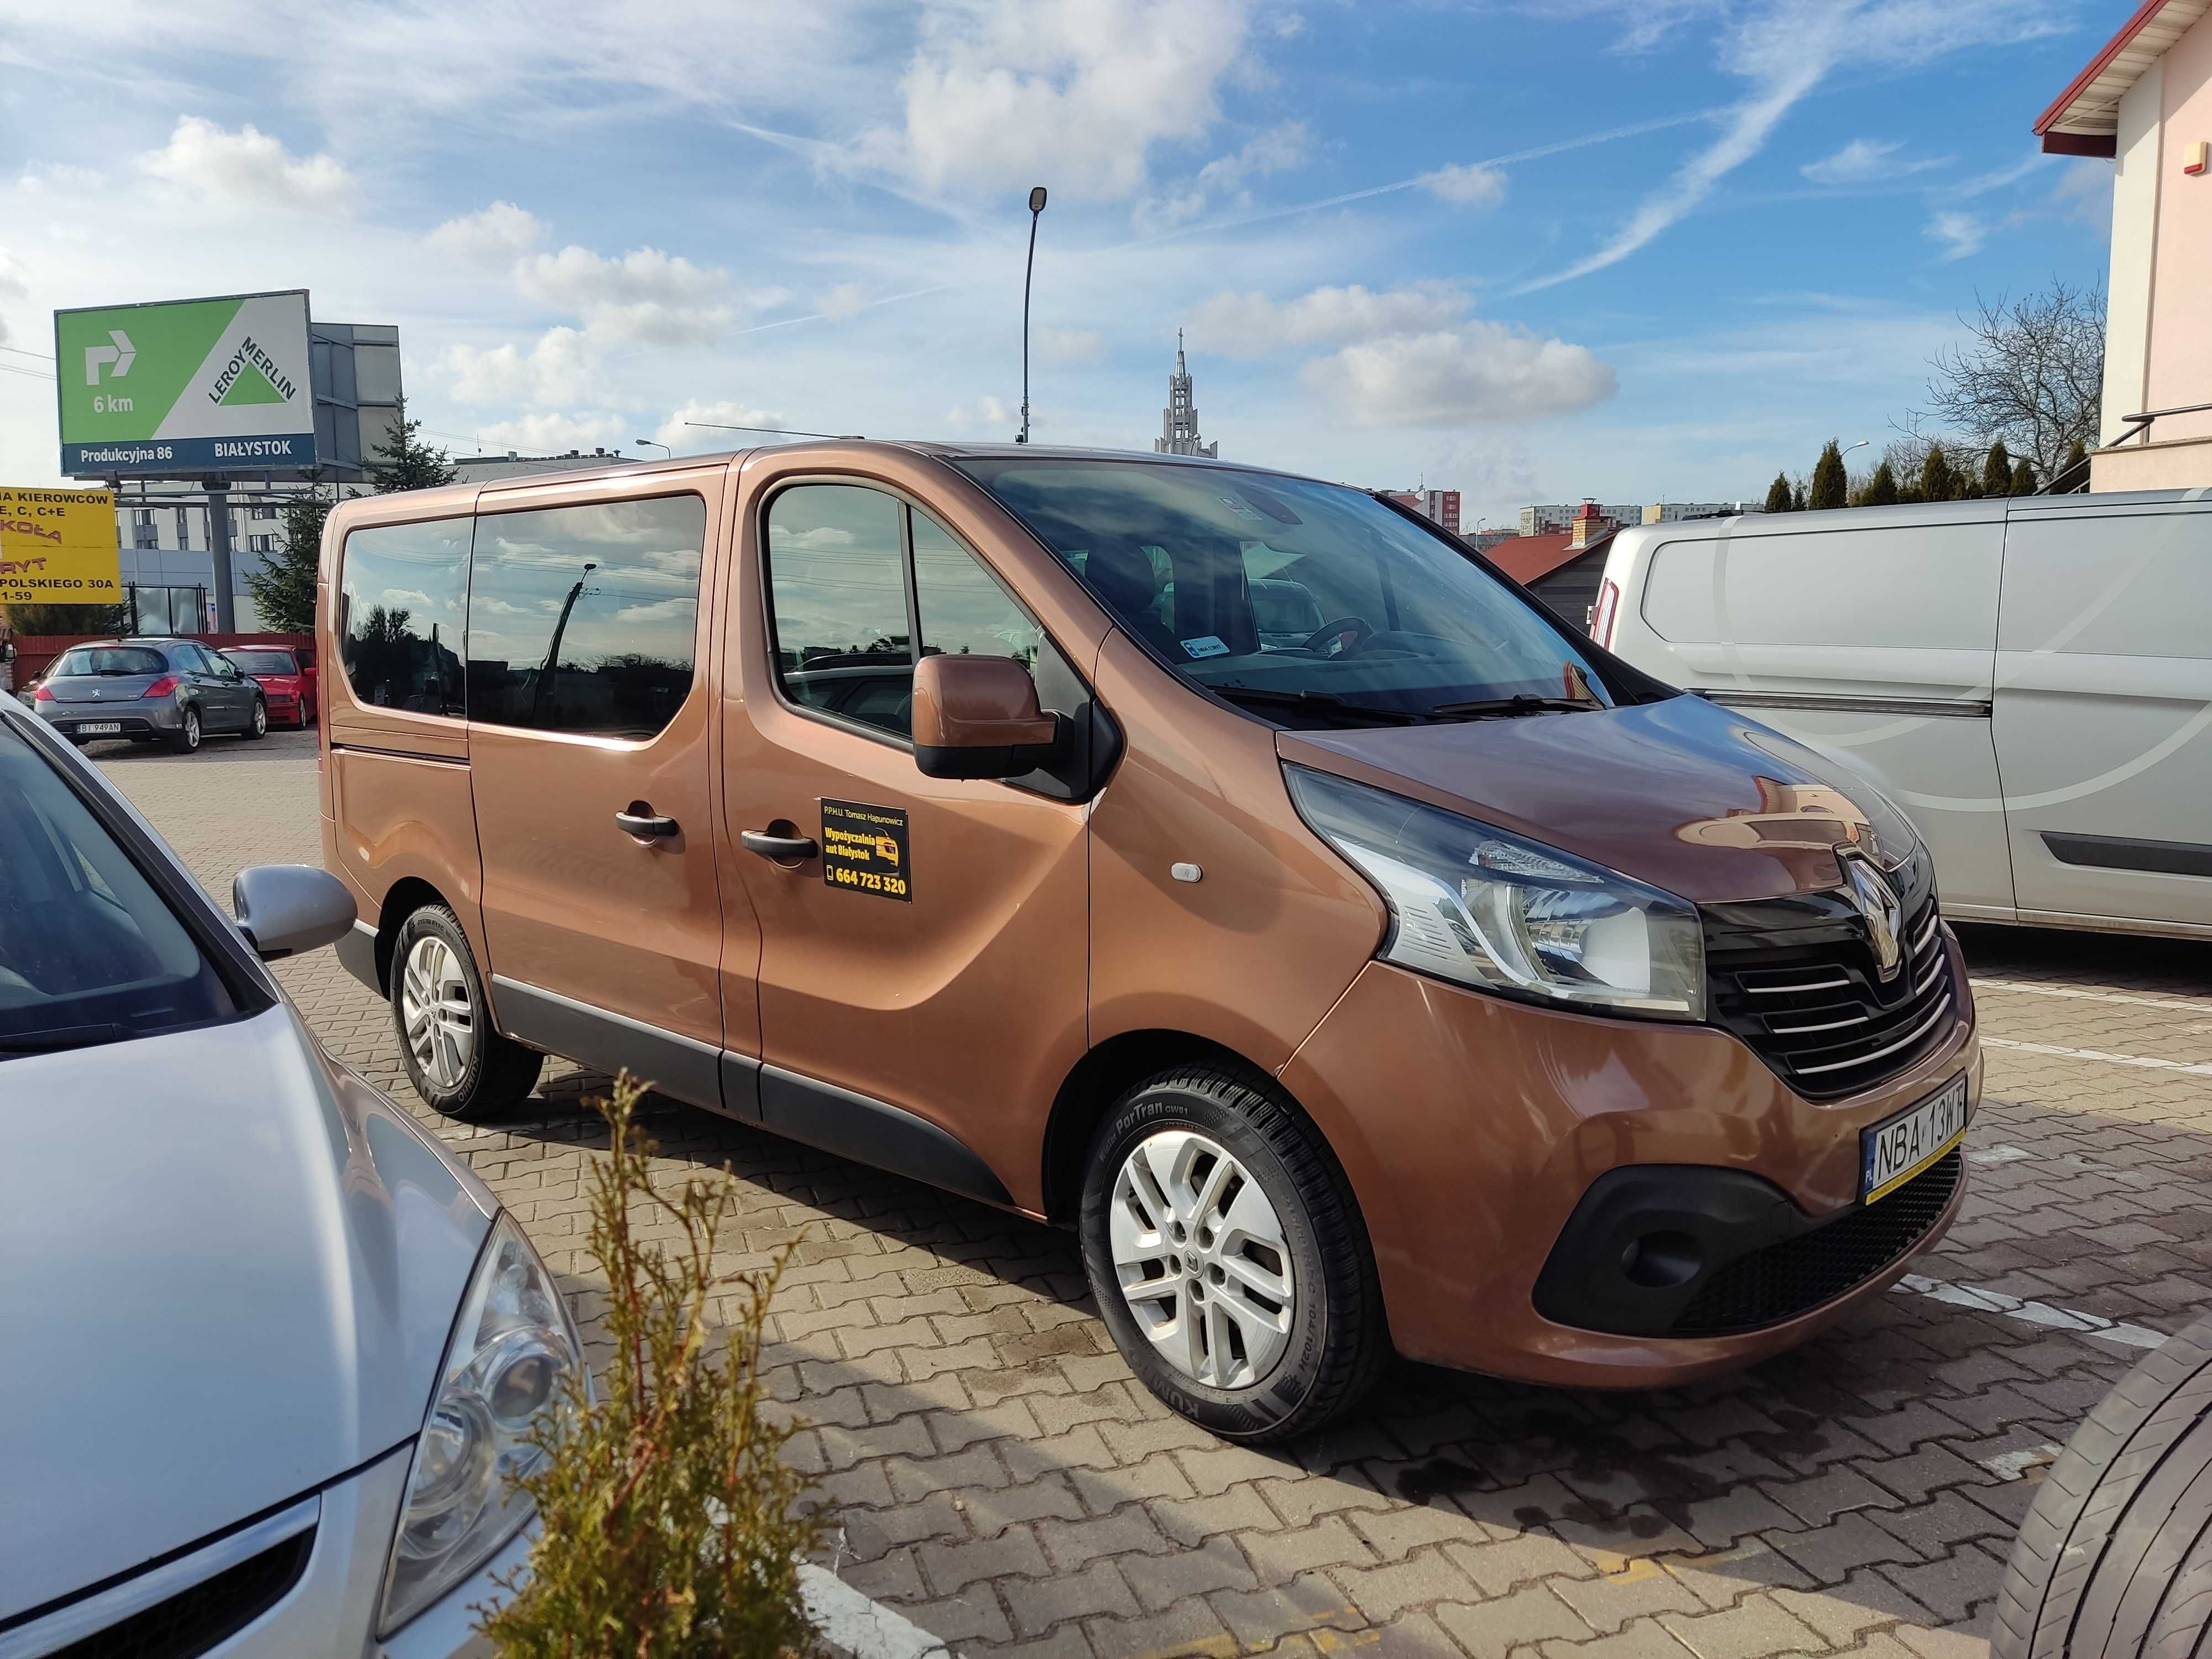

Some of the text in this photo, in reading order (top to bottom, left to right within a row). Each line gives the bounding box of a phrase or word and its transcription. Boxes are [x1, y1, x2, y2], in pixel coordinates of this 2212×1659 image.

[208, 336, 296, 404] LEROY MERLIN
[93, 395, 133, 413] 6 km
[81, 446, 173, 463] Produkcyjna 86
[215, 440, 292, 457] BIAŁYSTOK
[18, 493, 108, 504] KIEROWCÓW
[37, 507, 65, 517] C+E
[0, 579, 114, 588] POLSKIEGO 30A
[1, 592, 32, 601] 1-59
[845, 809, 866, 821] Tomasz
[825, 827, 875, 846] Wypożyczalnia
[826, 844, 870, 860] aut Białystok
[836, 868, 906, 895] 664 723 320
[1115, 1102, 1162, 1135] PorTran
[1878, 1115, 1919, 1181] NBA
[1929, 1082, 1964, 1148] 13WT
[1865, 1168, 1873, 1183] PL
